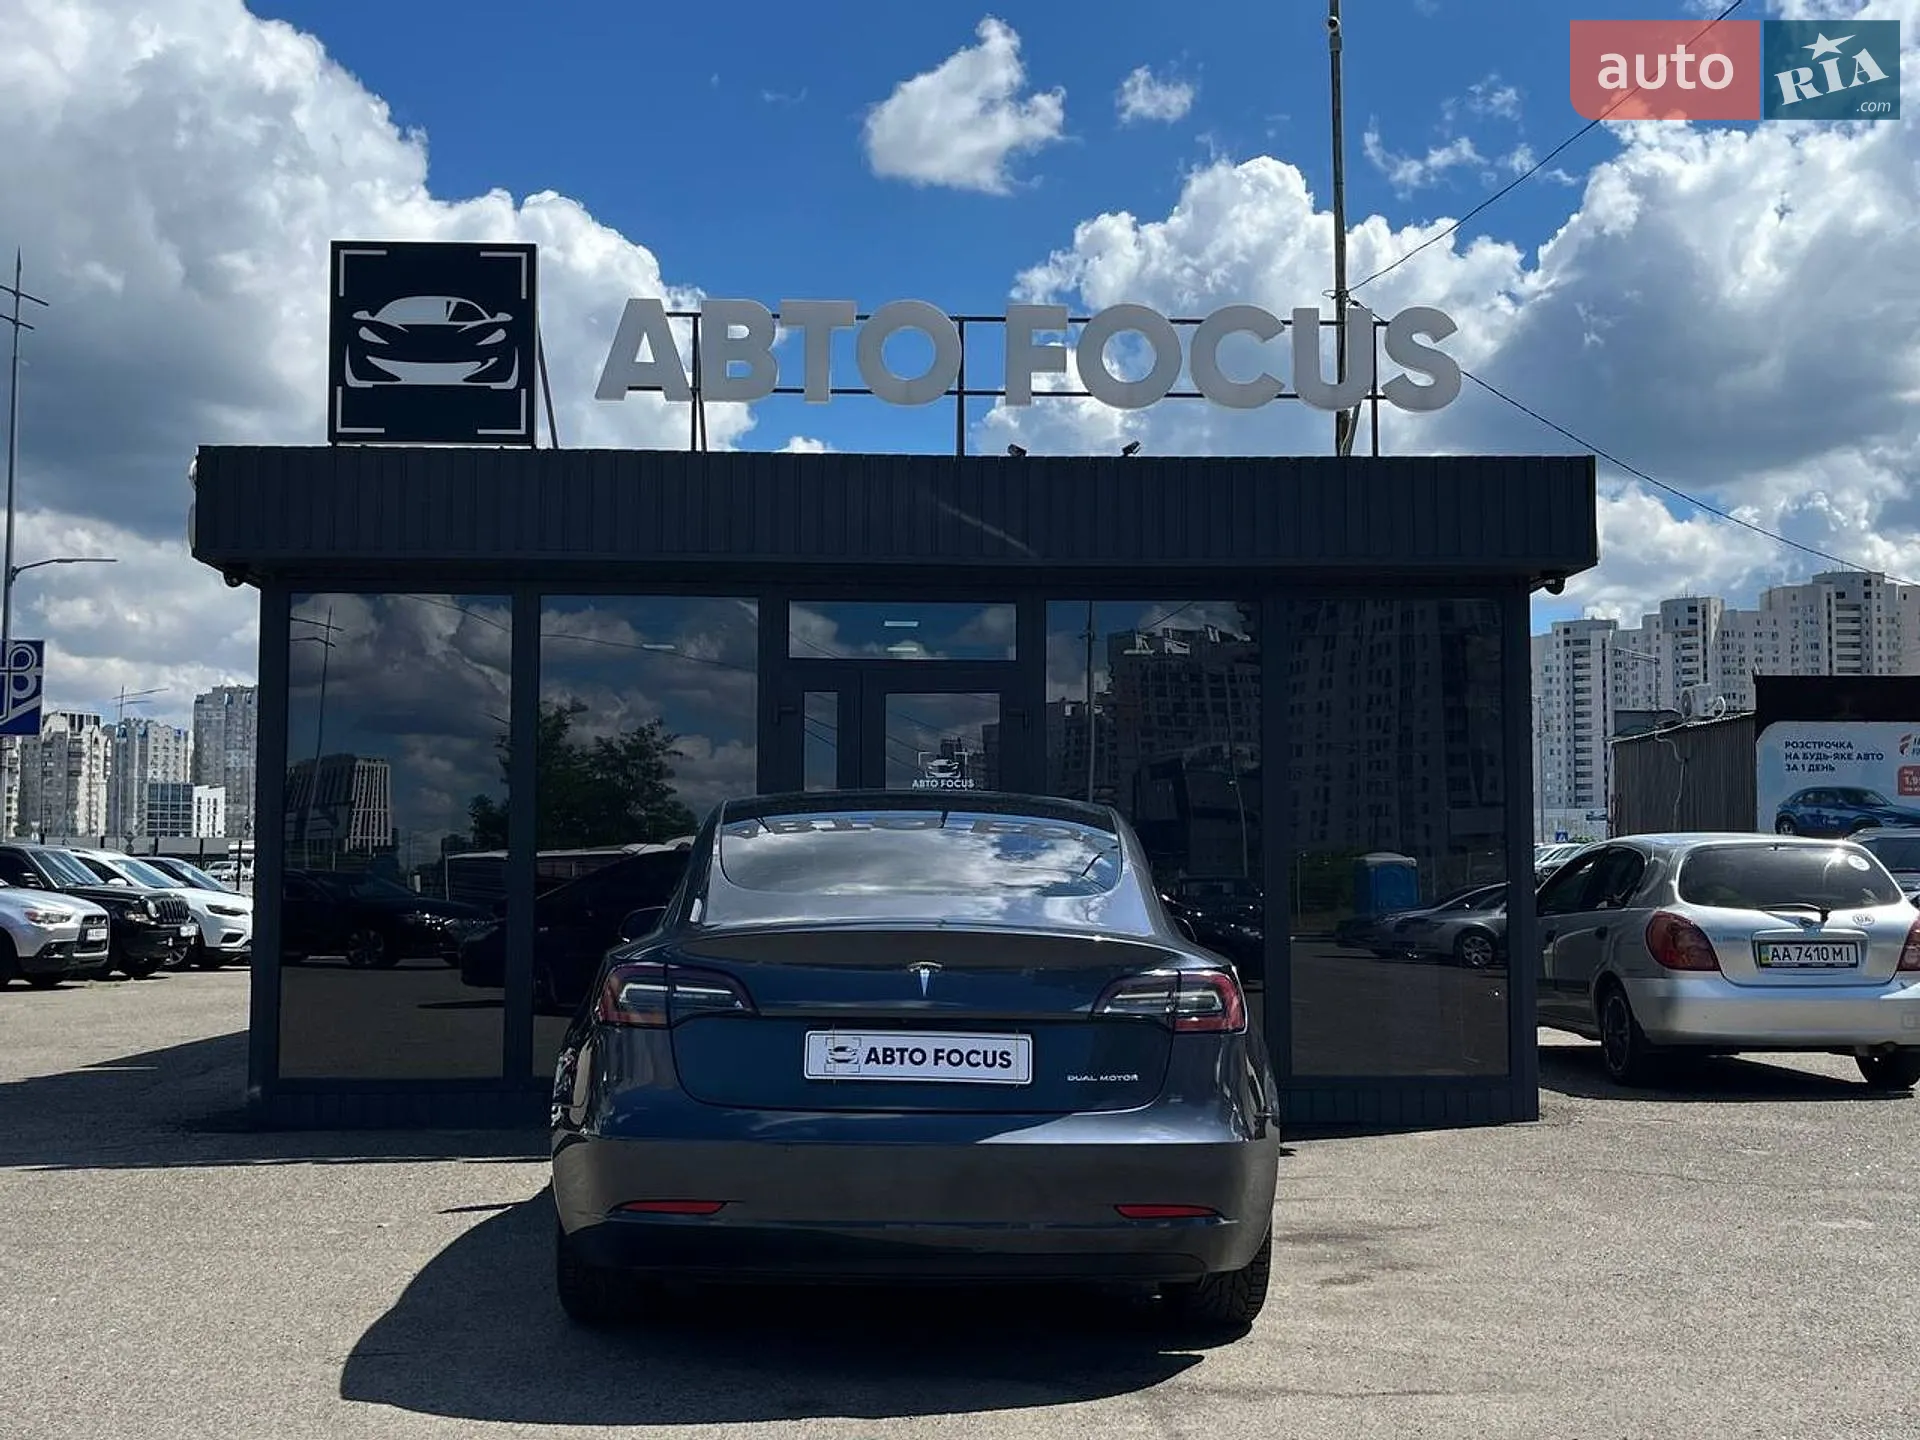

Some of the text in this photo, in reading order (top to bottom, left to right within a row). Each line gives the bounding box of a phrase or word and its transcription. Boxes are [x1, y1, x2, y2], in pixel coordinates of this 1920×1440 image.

[594, 298, 1461, 412] АВТО FOCUS
[1785, 741, 1854, 750] РОЗСТРОЧКА
[1808, 764, 1836, 772] ДЕНЬ
[941, 780, 975, 788] FOCUS
[864, 1047, 1012, 1069] АВТО FOCUS
